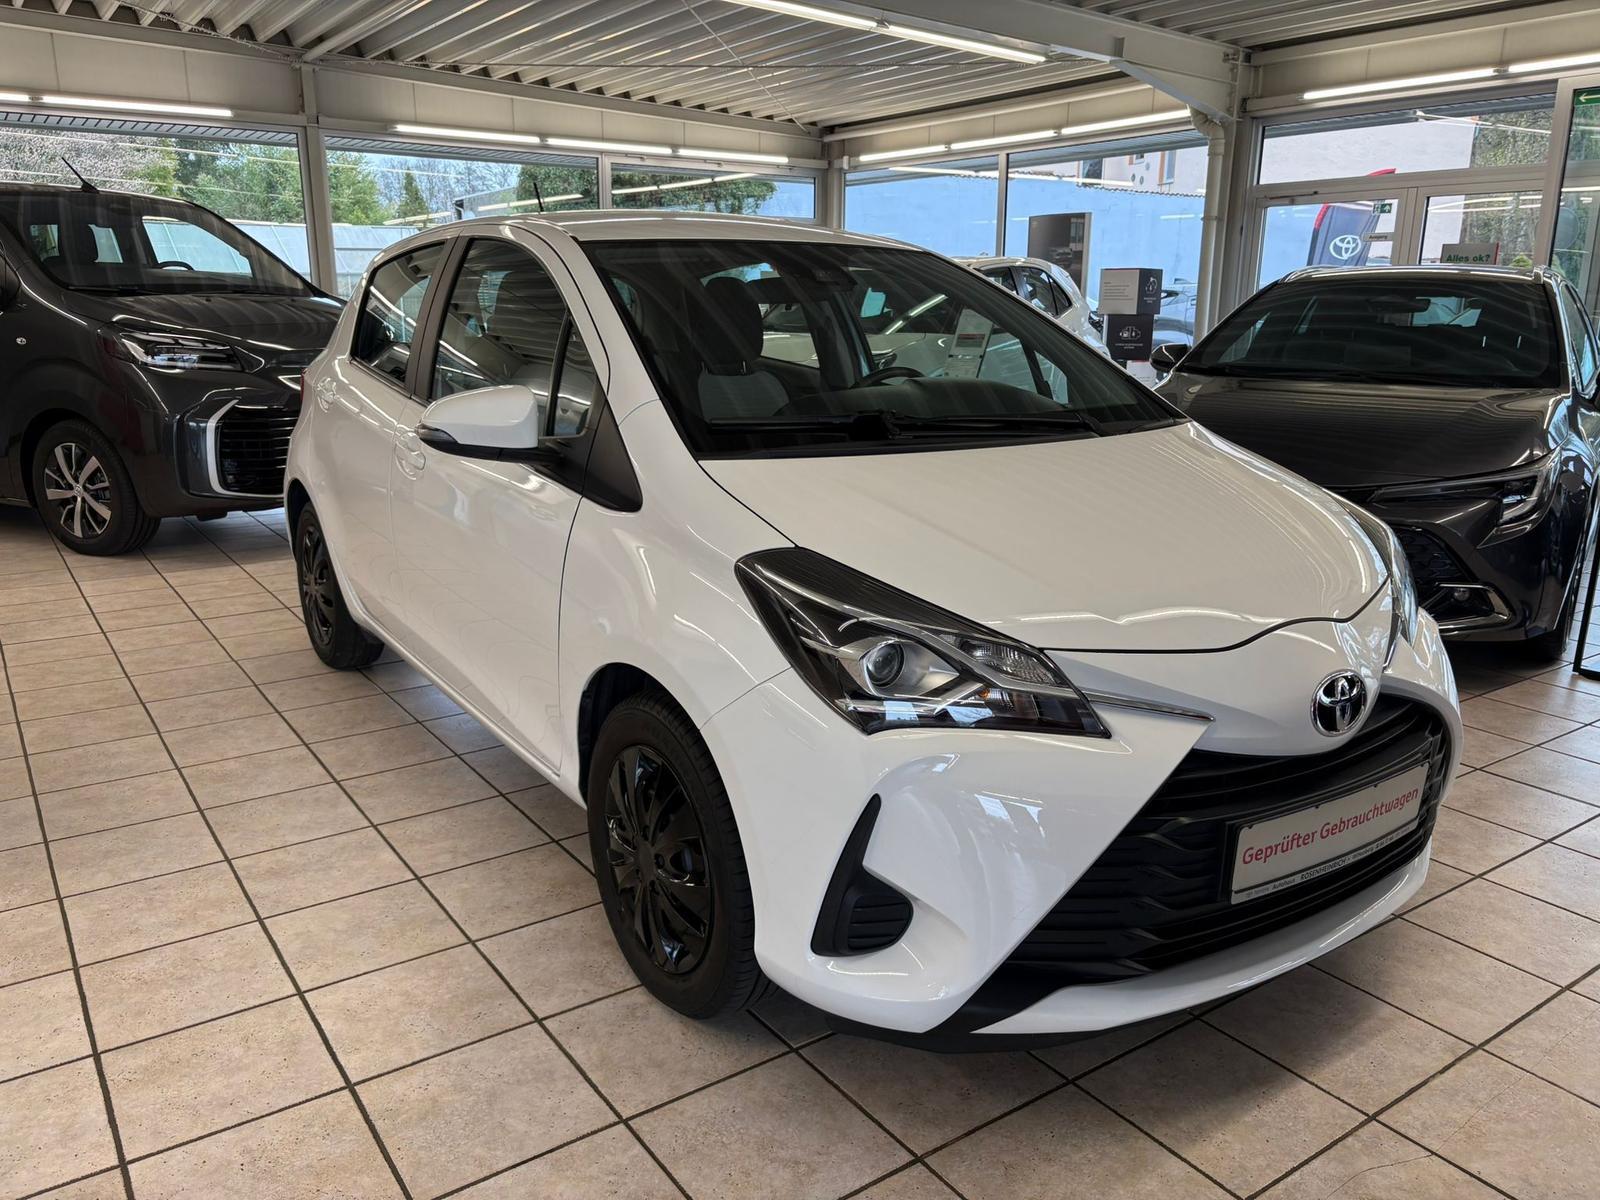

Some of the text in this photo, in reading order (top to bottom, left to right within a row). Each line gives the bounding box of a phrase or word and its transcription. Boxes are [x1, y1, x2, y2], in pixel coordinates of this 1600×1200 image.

[1446, 254, 1490, 263] Alles ok?
[1242, 788, 1419, 865] Geprüfter Gebrauchtwagen
